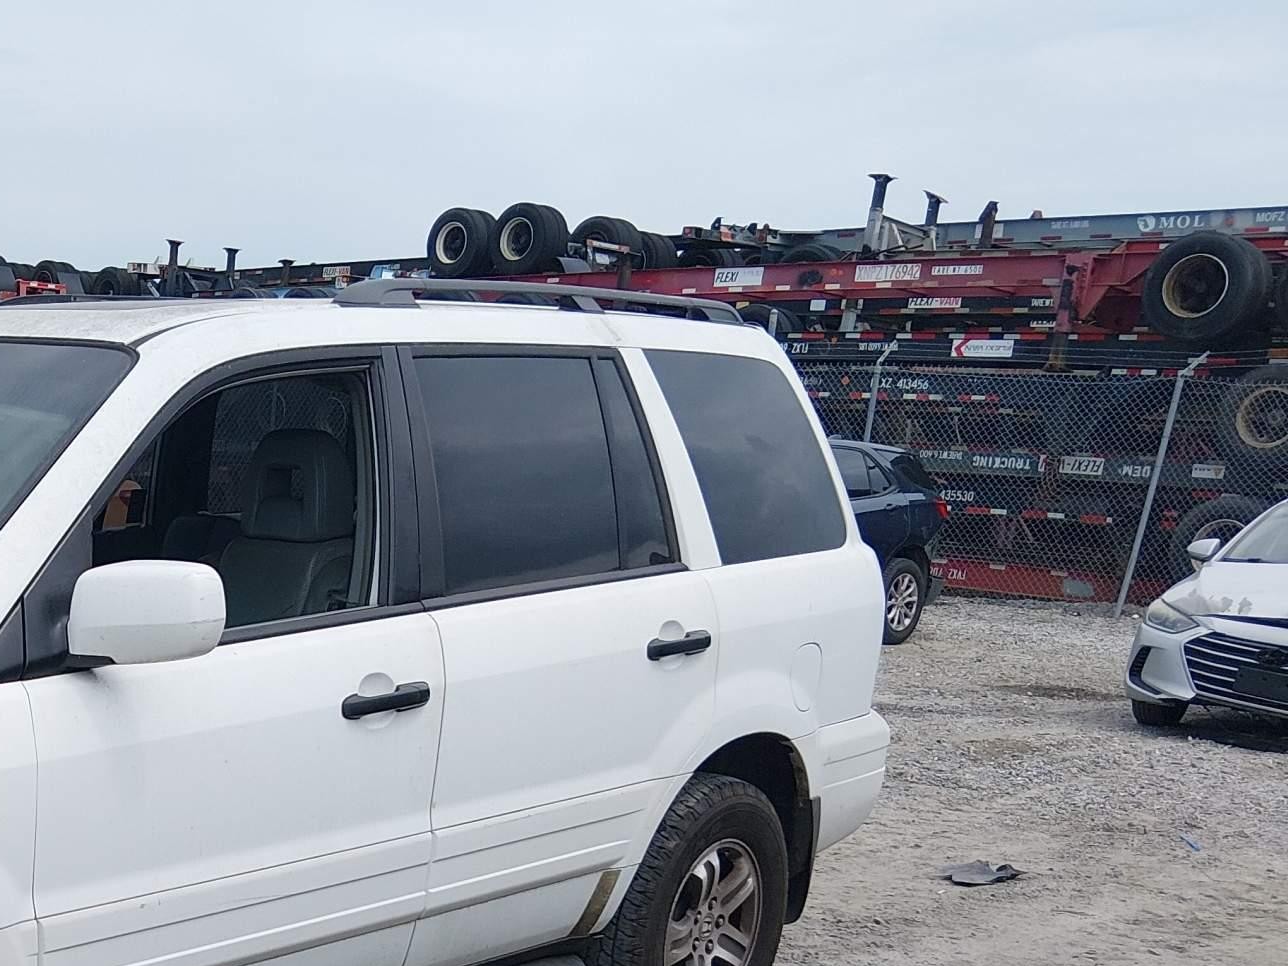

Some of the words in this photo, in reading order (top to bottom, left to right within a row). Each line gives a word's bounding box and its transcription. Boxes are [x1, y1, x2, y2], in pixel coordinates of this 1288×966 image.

[1158, 214, 1205, 230] MOL
[1255, 210, 1286, 223] MOFZ
[909, 297, 961, 308] FLEXI-VAN
[972, 455, 1031, 470] TRUCKING
